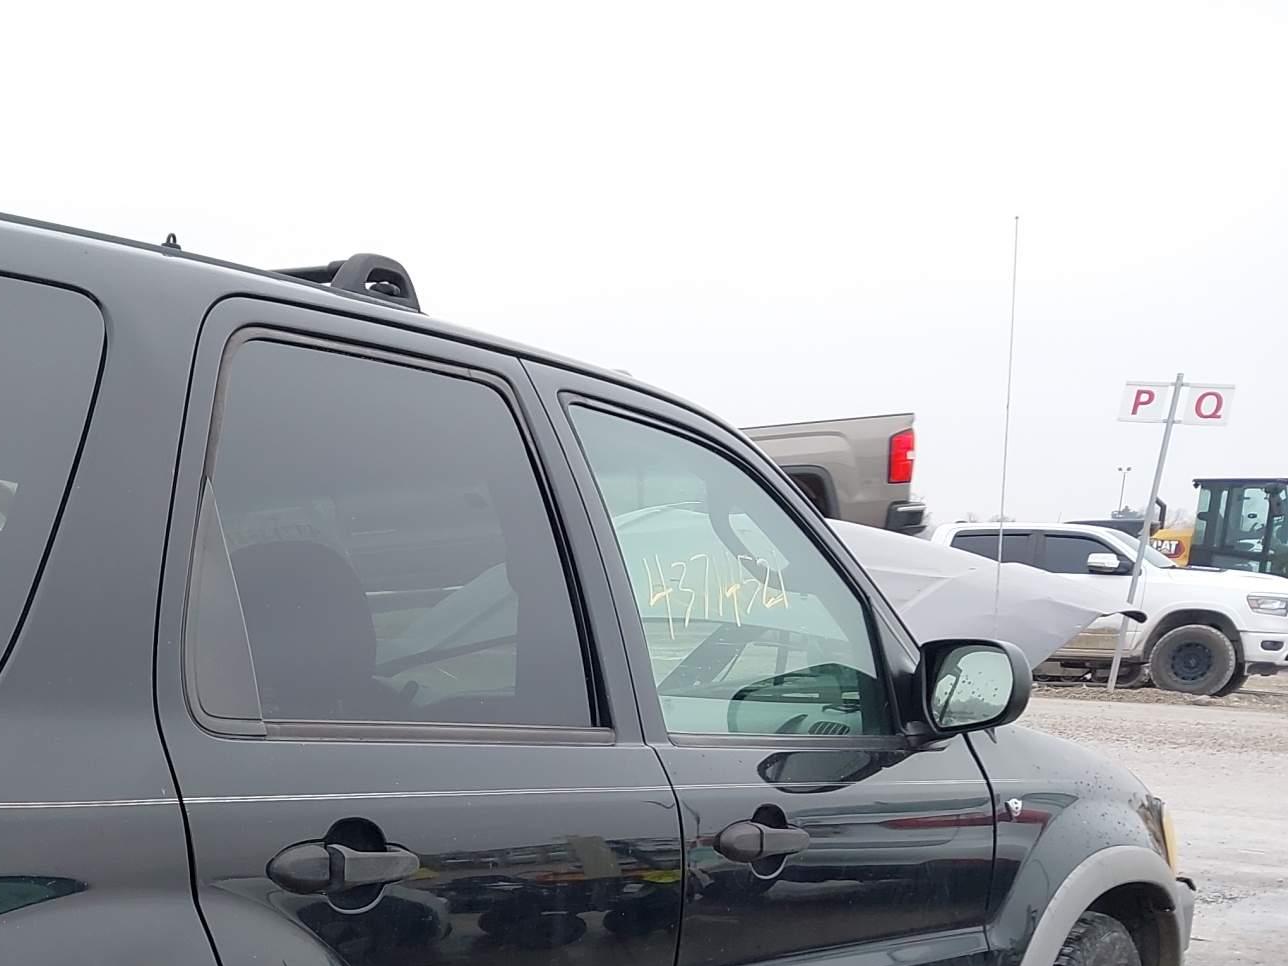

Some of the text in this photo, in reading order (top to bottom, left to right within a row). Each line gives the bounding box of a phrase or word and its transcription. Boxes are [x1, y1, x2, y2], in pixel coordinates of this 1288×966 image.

[1130, 388, 1156, 416] P
[1194, 391, 1224, 419] Q
[1151, 540, 1180, 555] CAT
